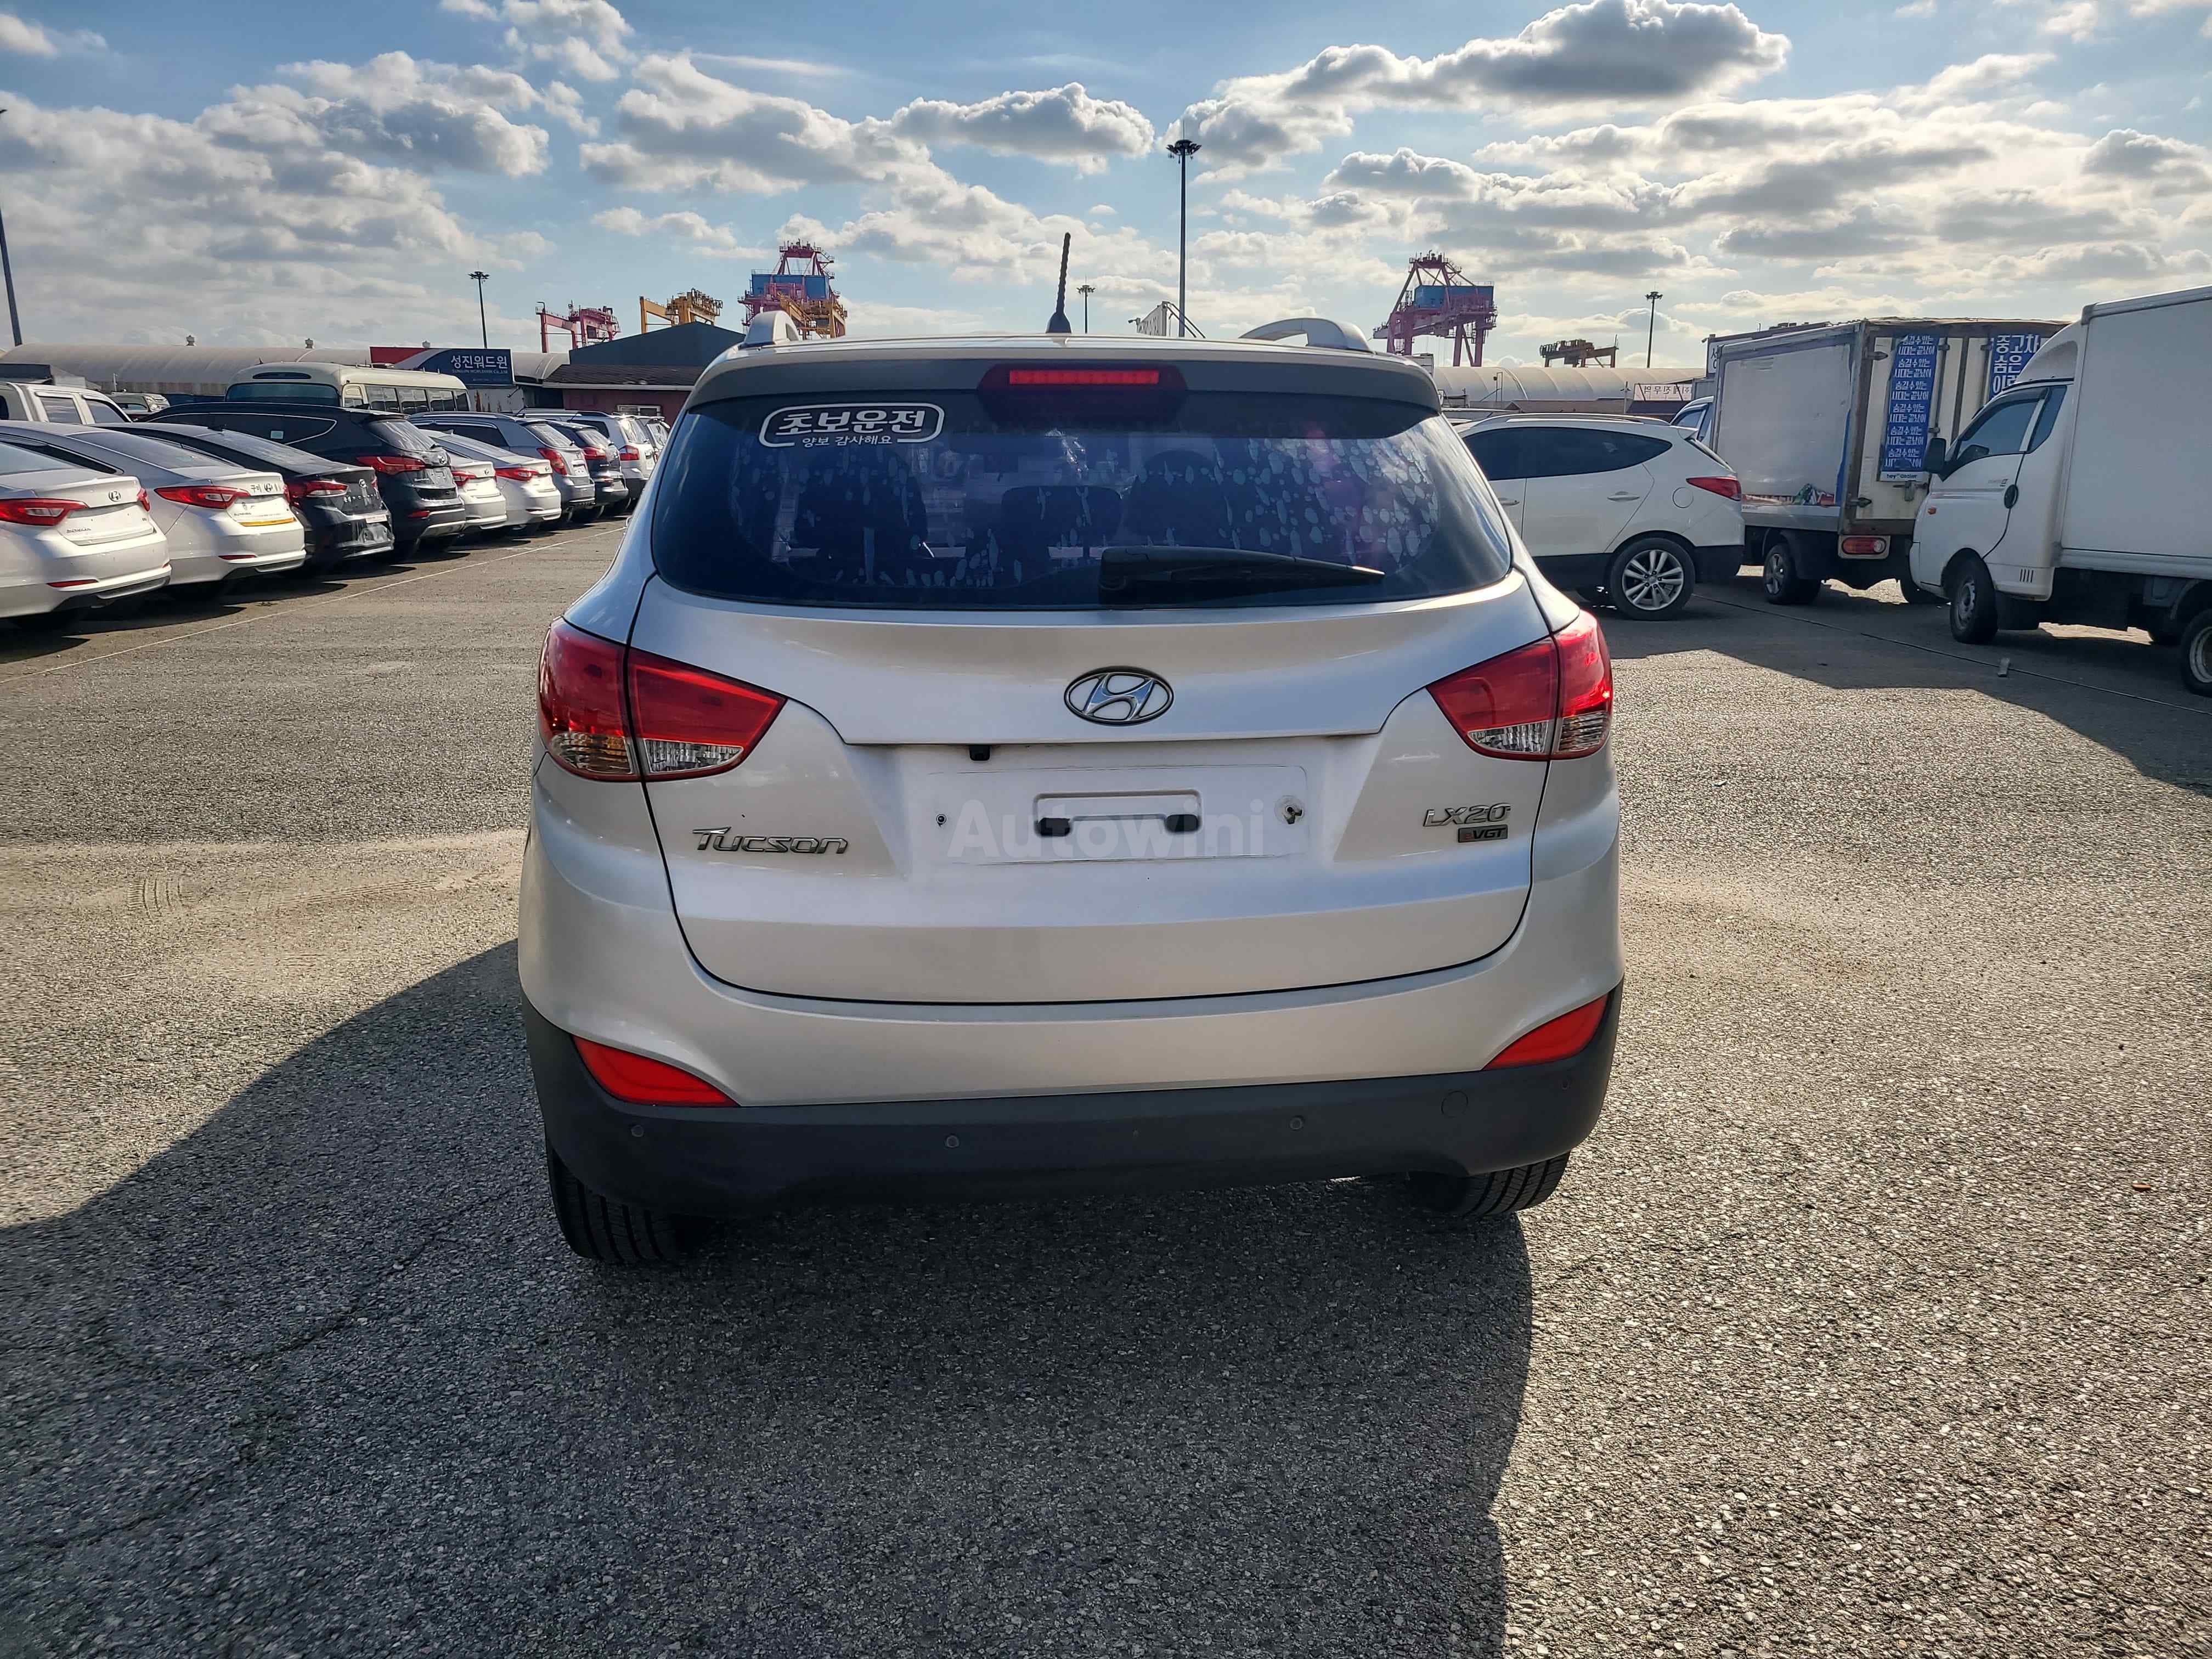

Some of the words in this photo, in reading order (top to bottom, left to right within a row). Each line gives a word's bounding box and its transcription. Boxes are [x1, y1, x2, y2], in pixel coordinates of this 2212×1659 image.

[1996, 334, 2040, 353] 중고차
[450, 355, 507, 369] 성진워드윈
[1994, 355, 2022, 374] 숨은
[775, 410, 926, 435] 초보운전
[802, 436, 830, 448] 양보
[834, 435, 893, 447] 감사해요
[1423, 803, 1511, 827] LX20
[692, 826, 849, 854] Tucson
